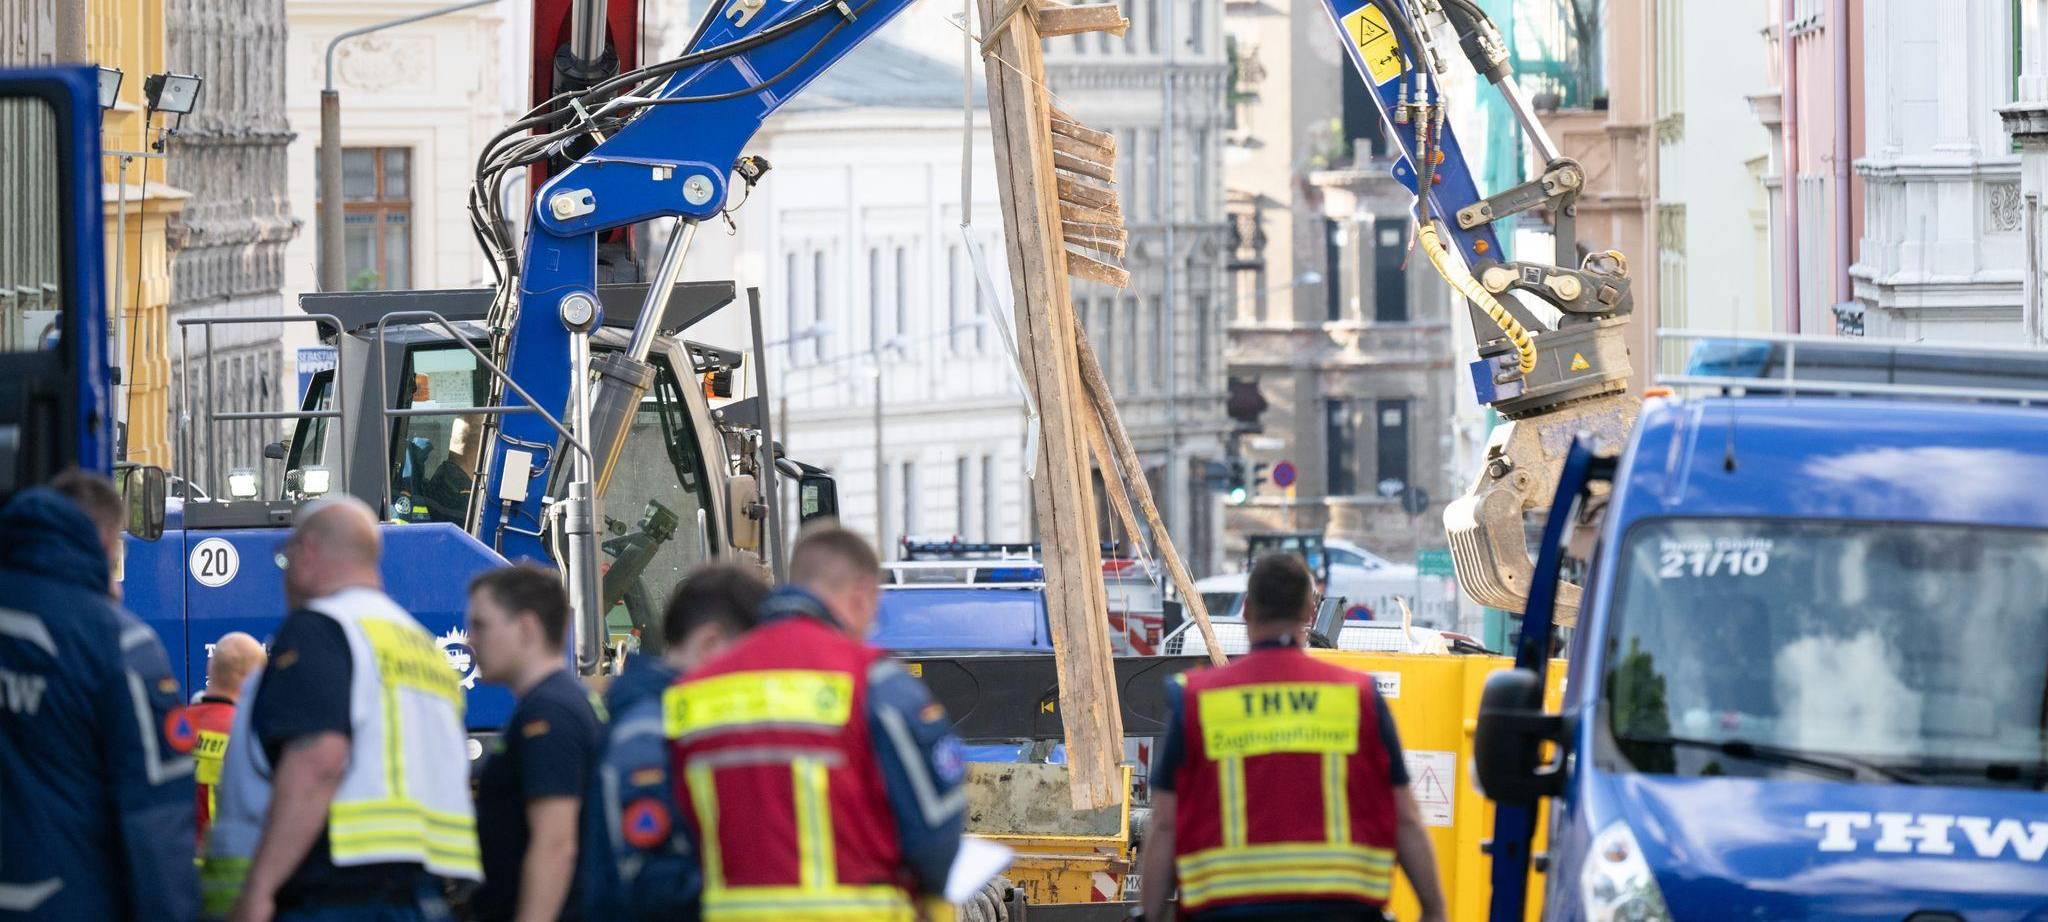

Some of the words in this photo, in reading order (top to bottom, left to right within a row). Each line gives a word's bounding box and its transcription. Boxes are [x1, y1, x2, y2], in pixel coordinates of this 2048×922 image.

[201, 548, 228, 577] 20
[1659, 551, 1769, 578] 21/10
[1242, 691, 1318, 717] THW
[1805, 811, 2048, 862] THW
